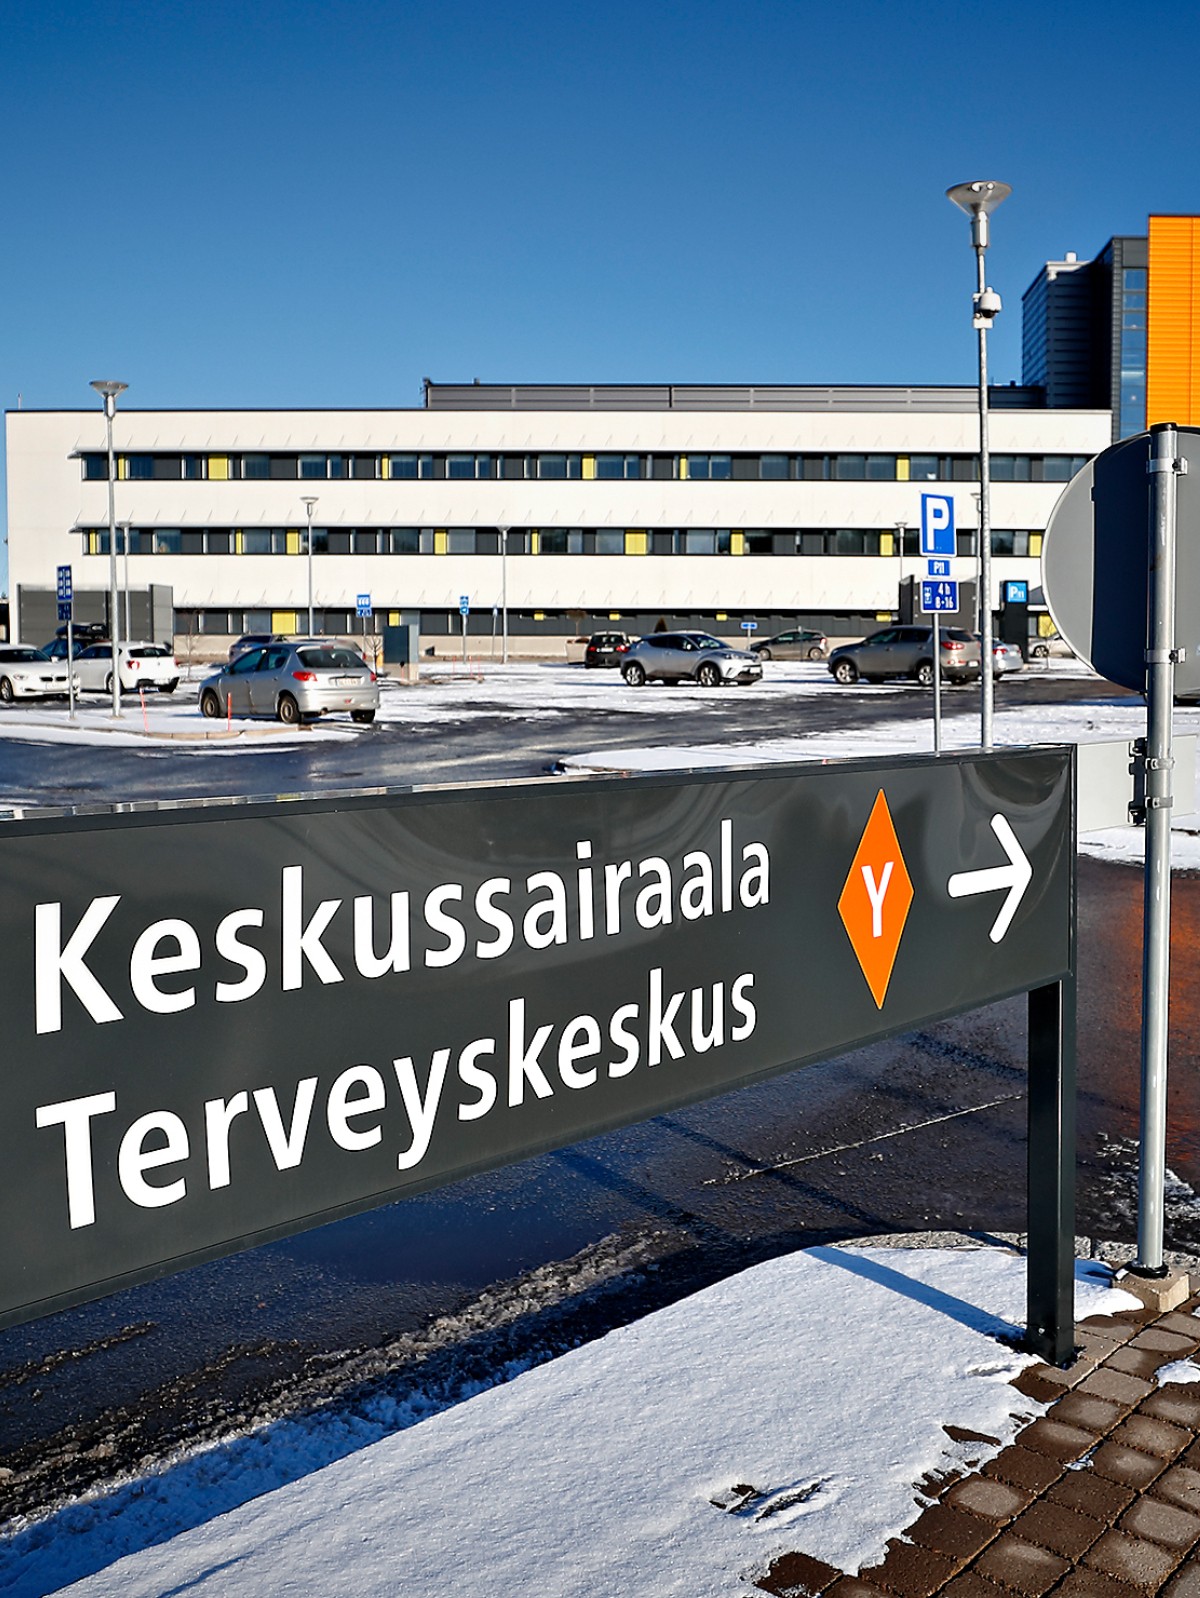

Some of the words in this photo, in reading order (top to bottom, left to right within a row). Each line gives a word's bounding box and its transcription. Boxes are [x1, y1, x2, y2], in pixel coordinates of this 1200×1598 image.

[926, 497, 950, 551] P
[937, 583, 944, 595] 4
[35, 819, 770, 1035] Keskussairaala
[861, 861, 894, 938] Y
[35, 967, 757, 1230] Terveyskeskus
